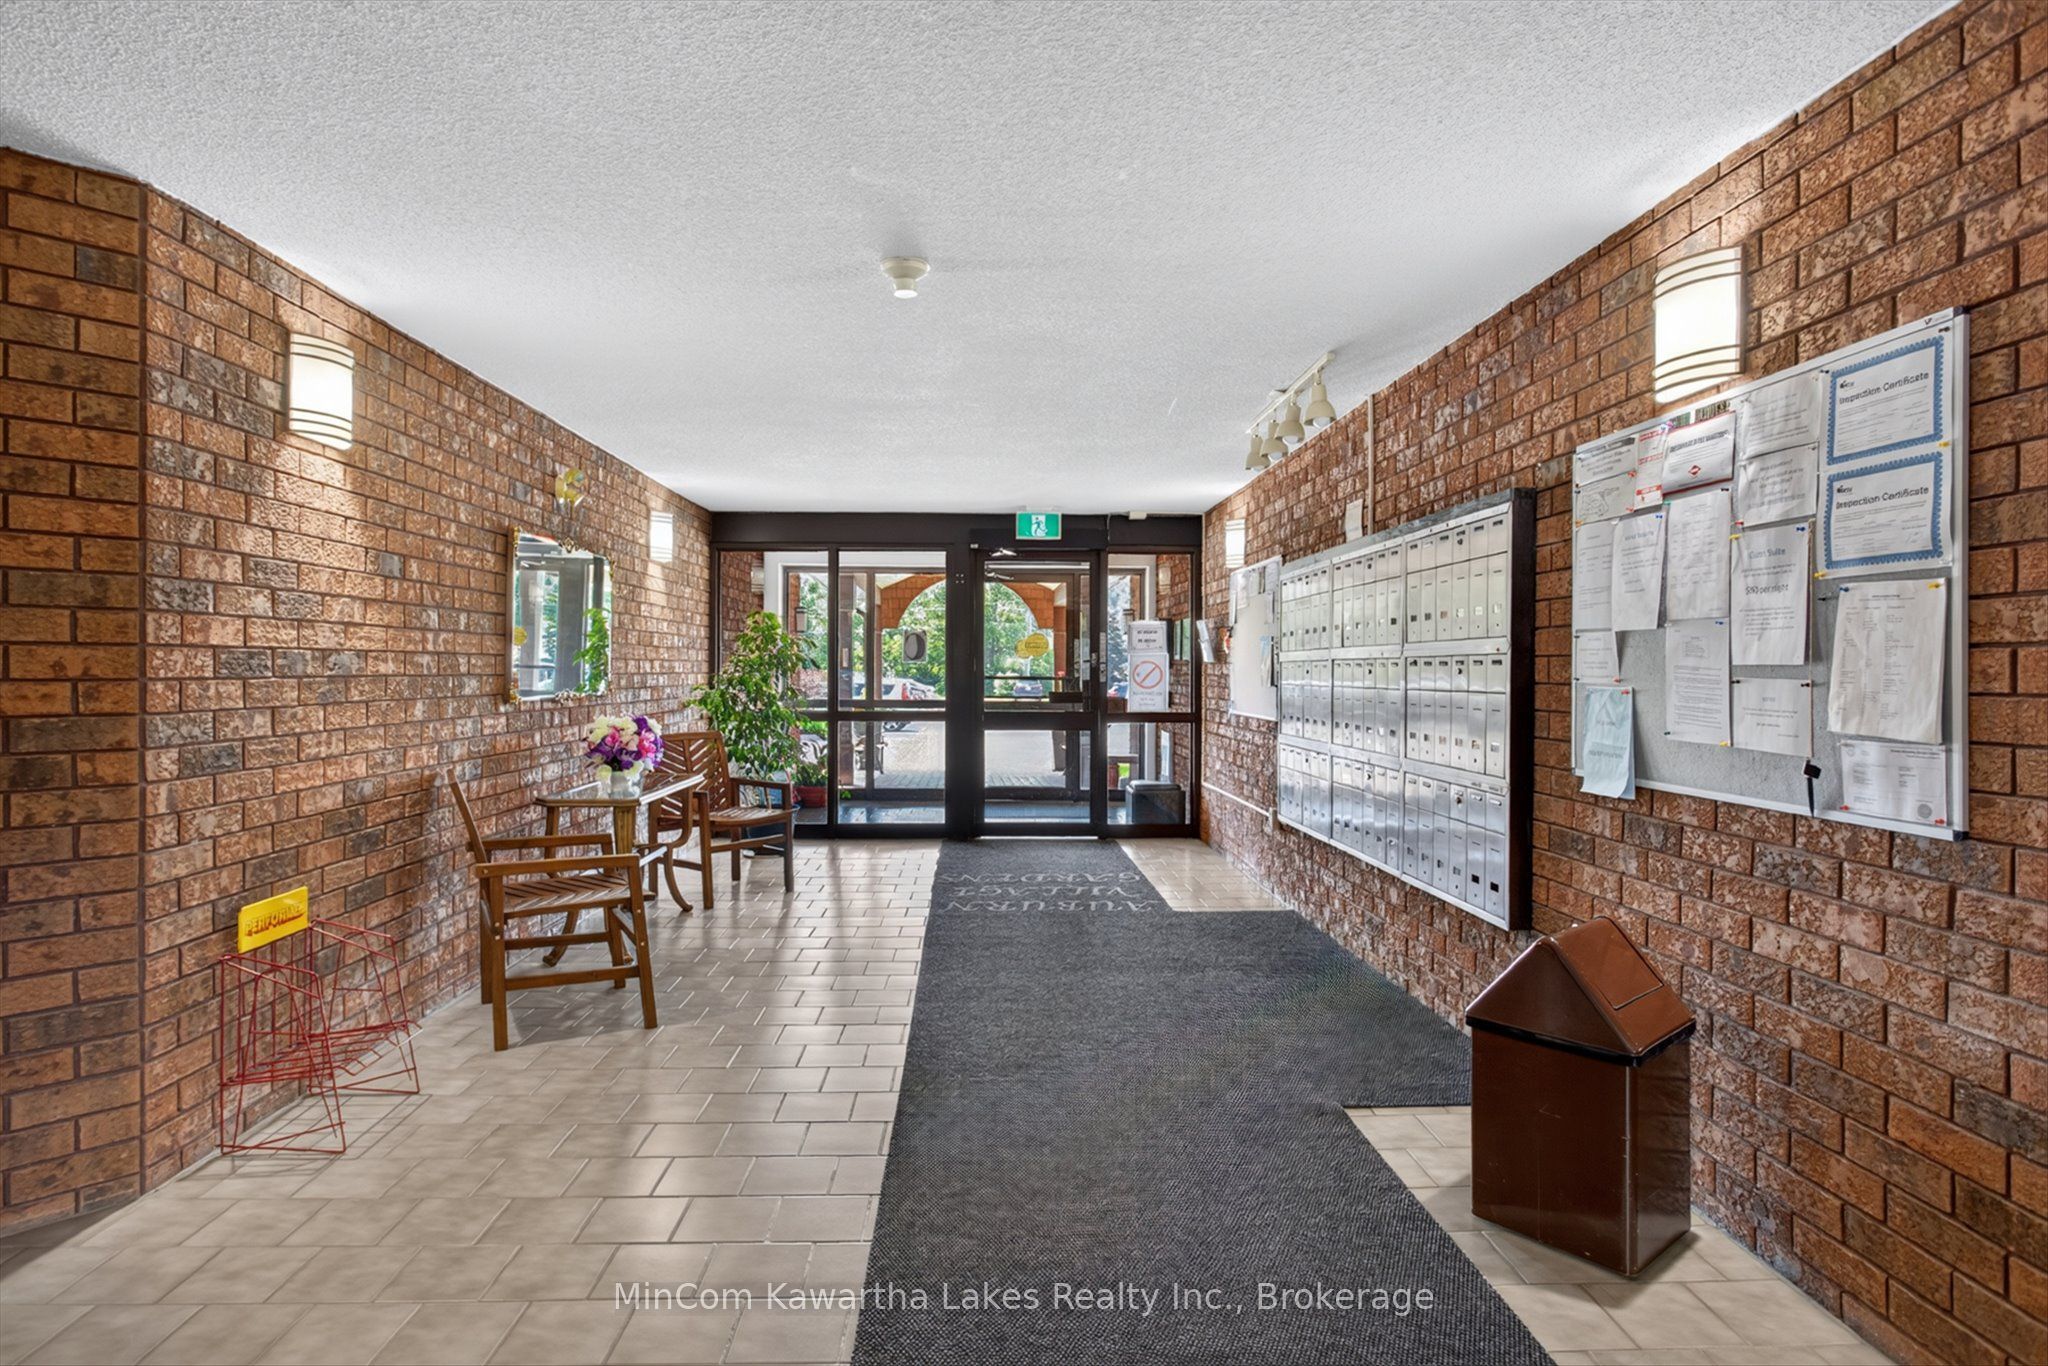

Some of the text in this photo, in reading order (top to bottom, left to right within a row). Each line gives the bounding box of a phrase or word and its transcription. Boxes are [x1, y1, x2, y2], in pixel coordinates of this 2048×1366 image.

[1882, 371, 1929, 392] Certificate
[1835, 486, 1929, 510] Inspection Certificate
[936, 872, 1141, 883] GARDENS
[950, 885, 1142, 897] VILLAGE
[938, 900, 1161, 912] AUBURN
